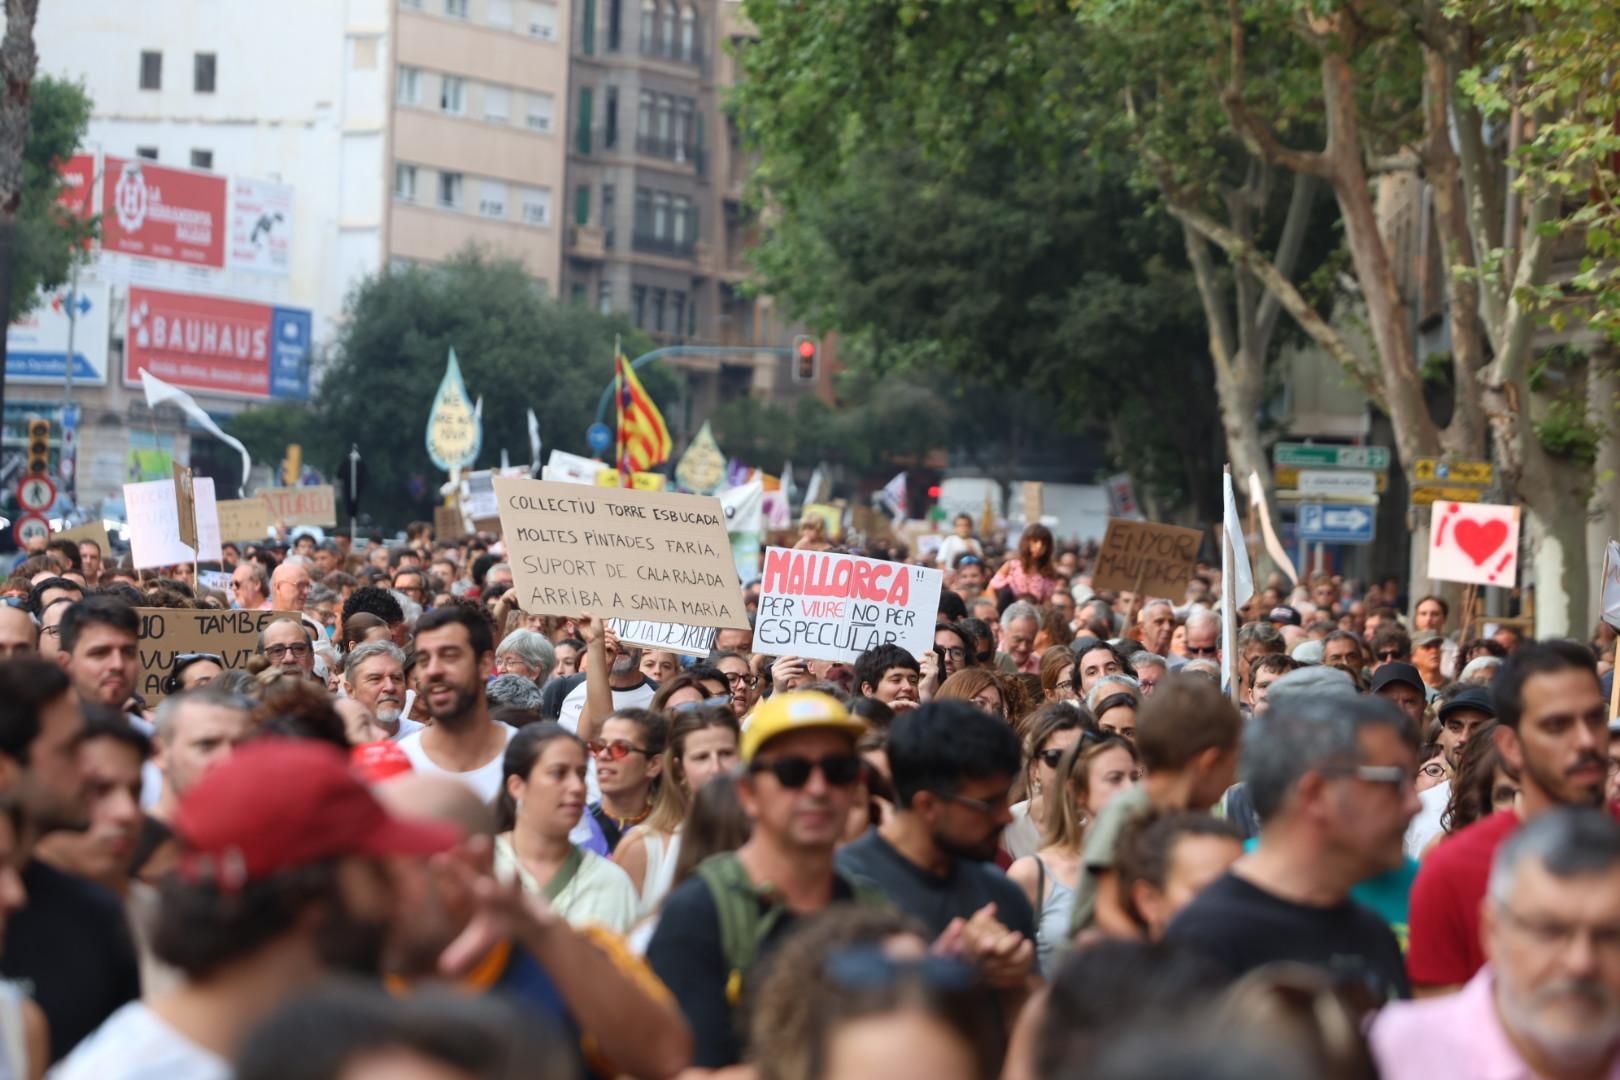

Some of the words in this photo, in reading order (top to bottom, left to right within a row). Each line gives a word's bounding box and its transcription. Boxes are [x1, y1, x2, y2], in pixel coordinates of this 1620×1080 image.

[153, 316, 267, 360] BAUHAUS
[605, 503, 647, 519] TORRE
[652, 508, 720, 526] ESBUCADA
[517, 526, 578, 544] MOLTES
[1110, 525, 1194, 561] ENYOR
[522, 555, 596, 576] SUPORT
[606, 563, 627, 578] DE
[763, 550, 912, 607] MALLORCA
[612, 592, 625, 608] A
[631, 594, 678, 612] SANTA
[760, 596, 795, 616] PER
[801, 600, 846, 618] VIURE
[851, 603, 880, 622] NO
[886, 607, 916, 627] PER
[759, 618, 898, 652] ESPECULAR
